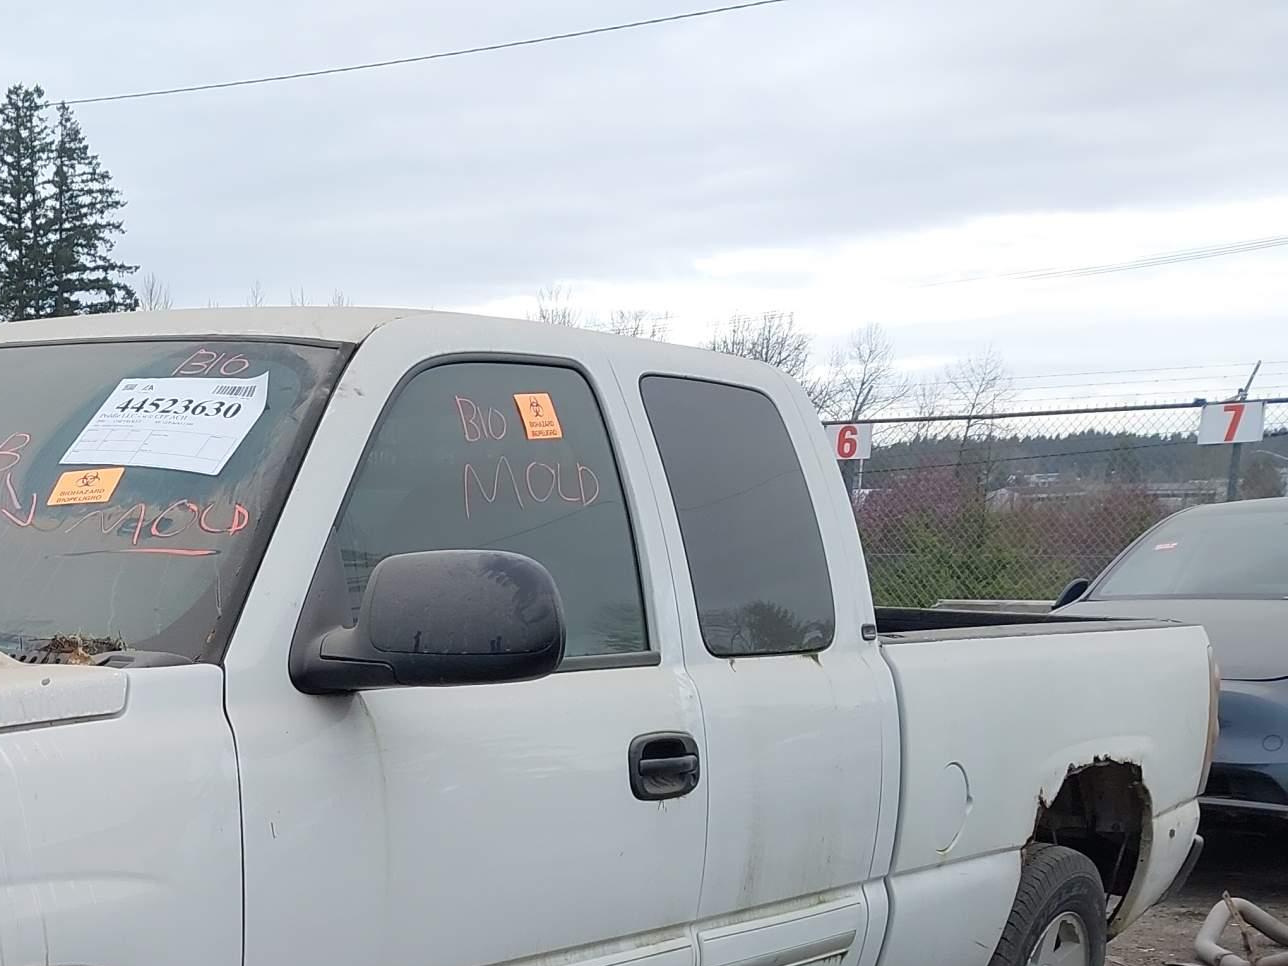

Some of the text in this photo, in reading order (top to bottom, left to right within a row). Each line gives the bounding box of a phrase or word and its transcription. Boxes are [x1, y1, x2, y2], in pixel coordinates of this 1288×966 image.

[115, 397, 242, 419] 44523630
[455, 395, 507, 442] BIO
[1223, 404, 1246, 442] 7
[837, 425, 858, 458] 6
[59, 488, 105, 497] BIOHAZARD
[464, 455, 600, 519] MOLD
